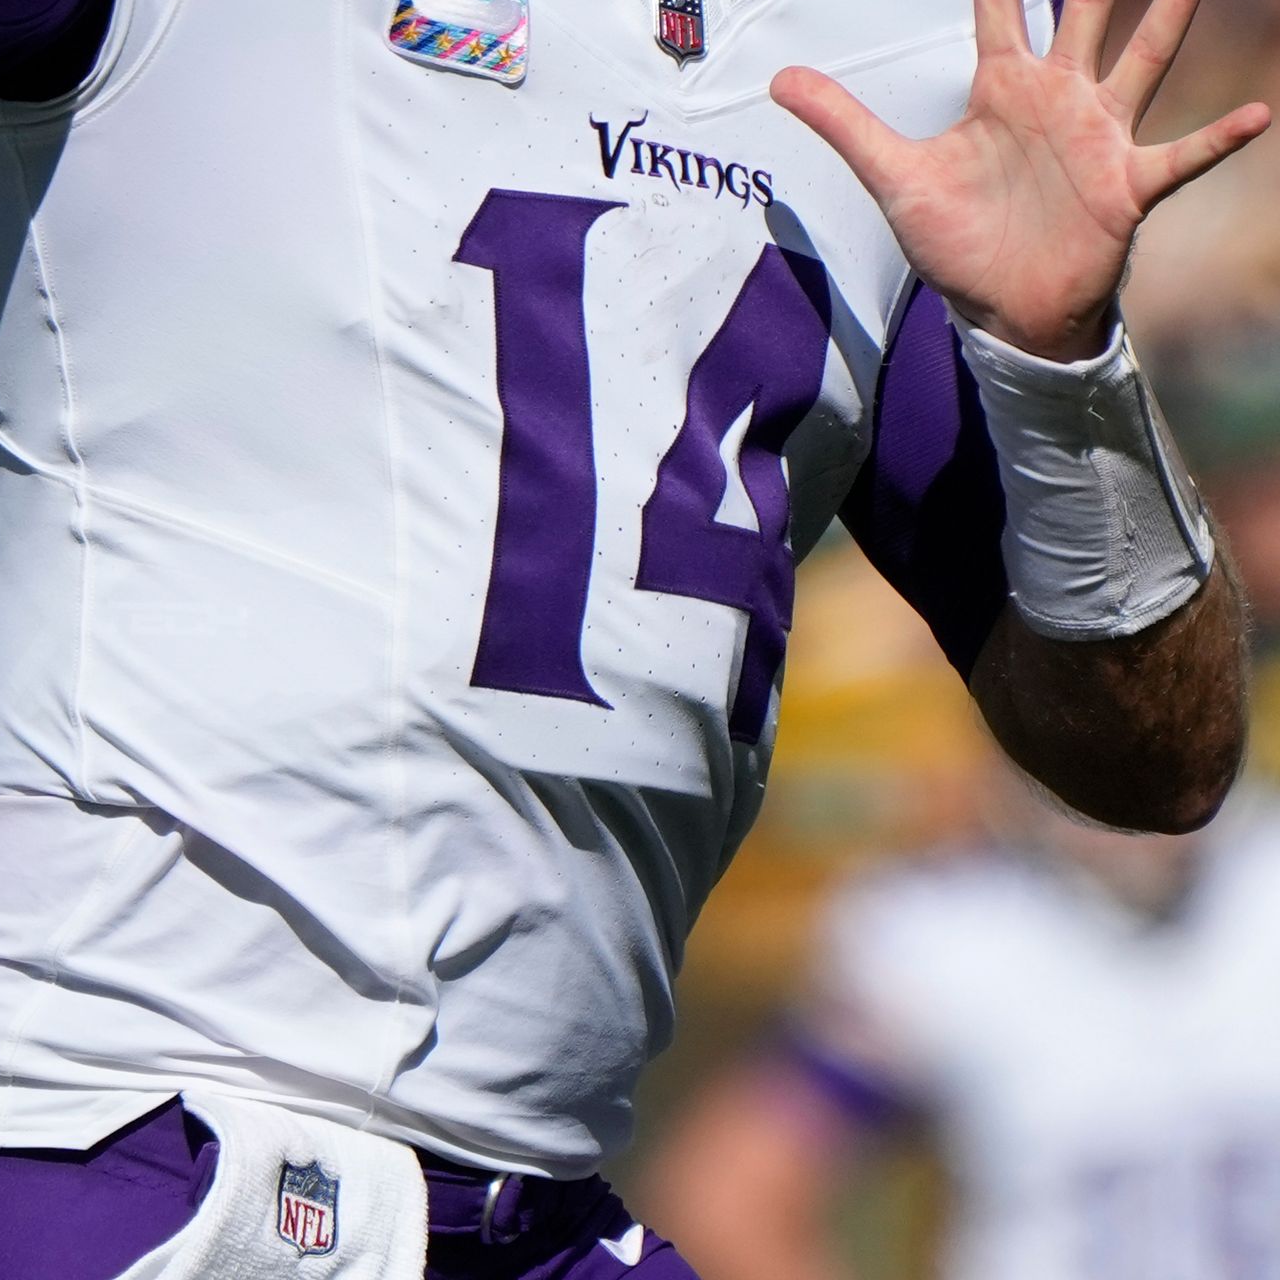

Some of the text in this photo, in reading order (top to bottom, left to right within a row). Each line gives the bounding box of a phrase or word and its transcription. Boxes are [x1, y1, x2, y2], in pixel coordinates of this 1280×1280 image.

[659, 8, 703, 50] NFL
[451, 186, 833, 746] 14
[281, 1195, 330, 1248] NFL
